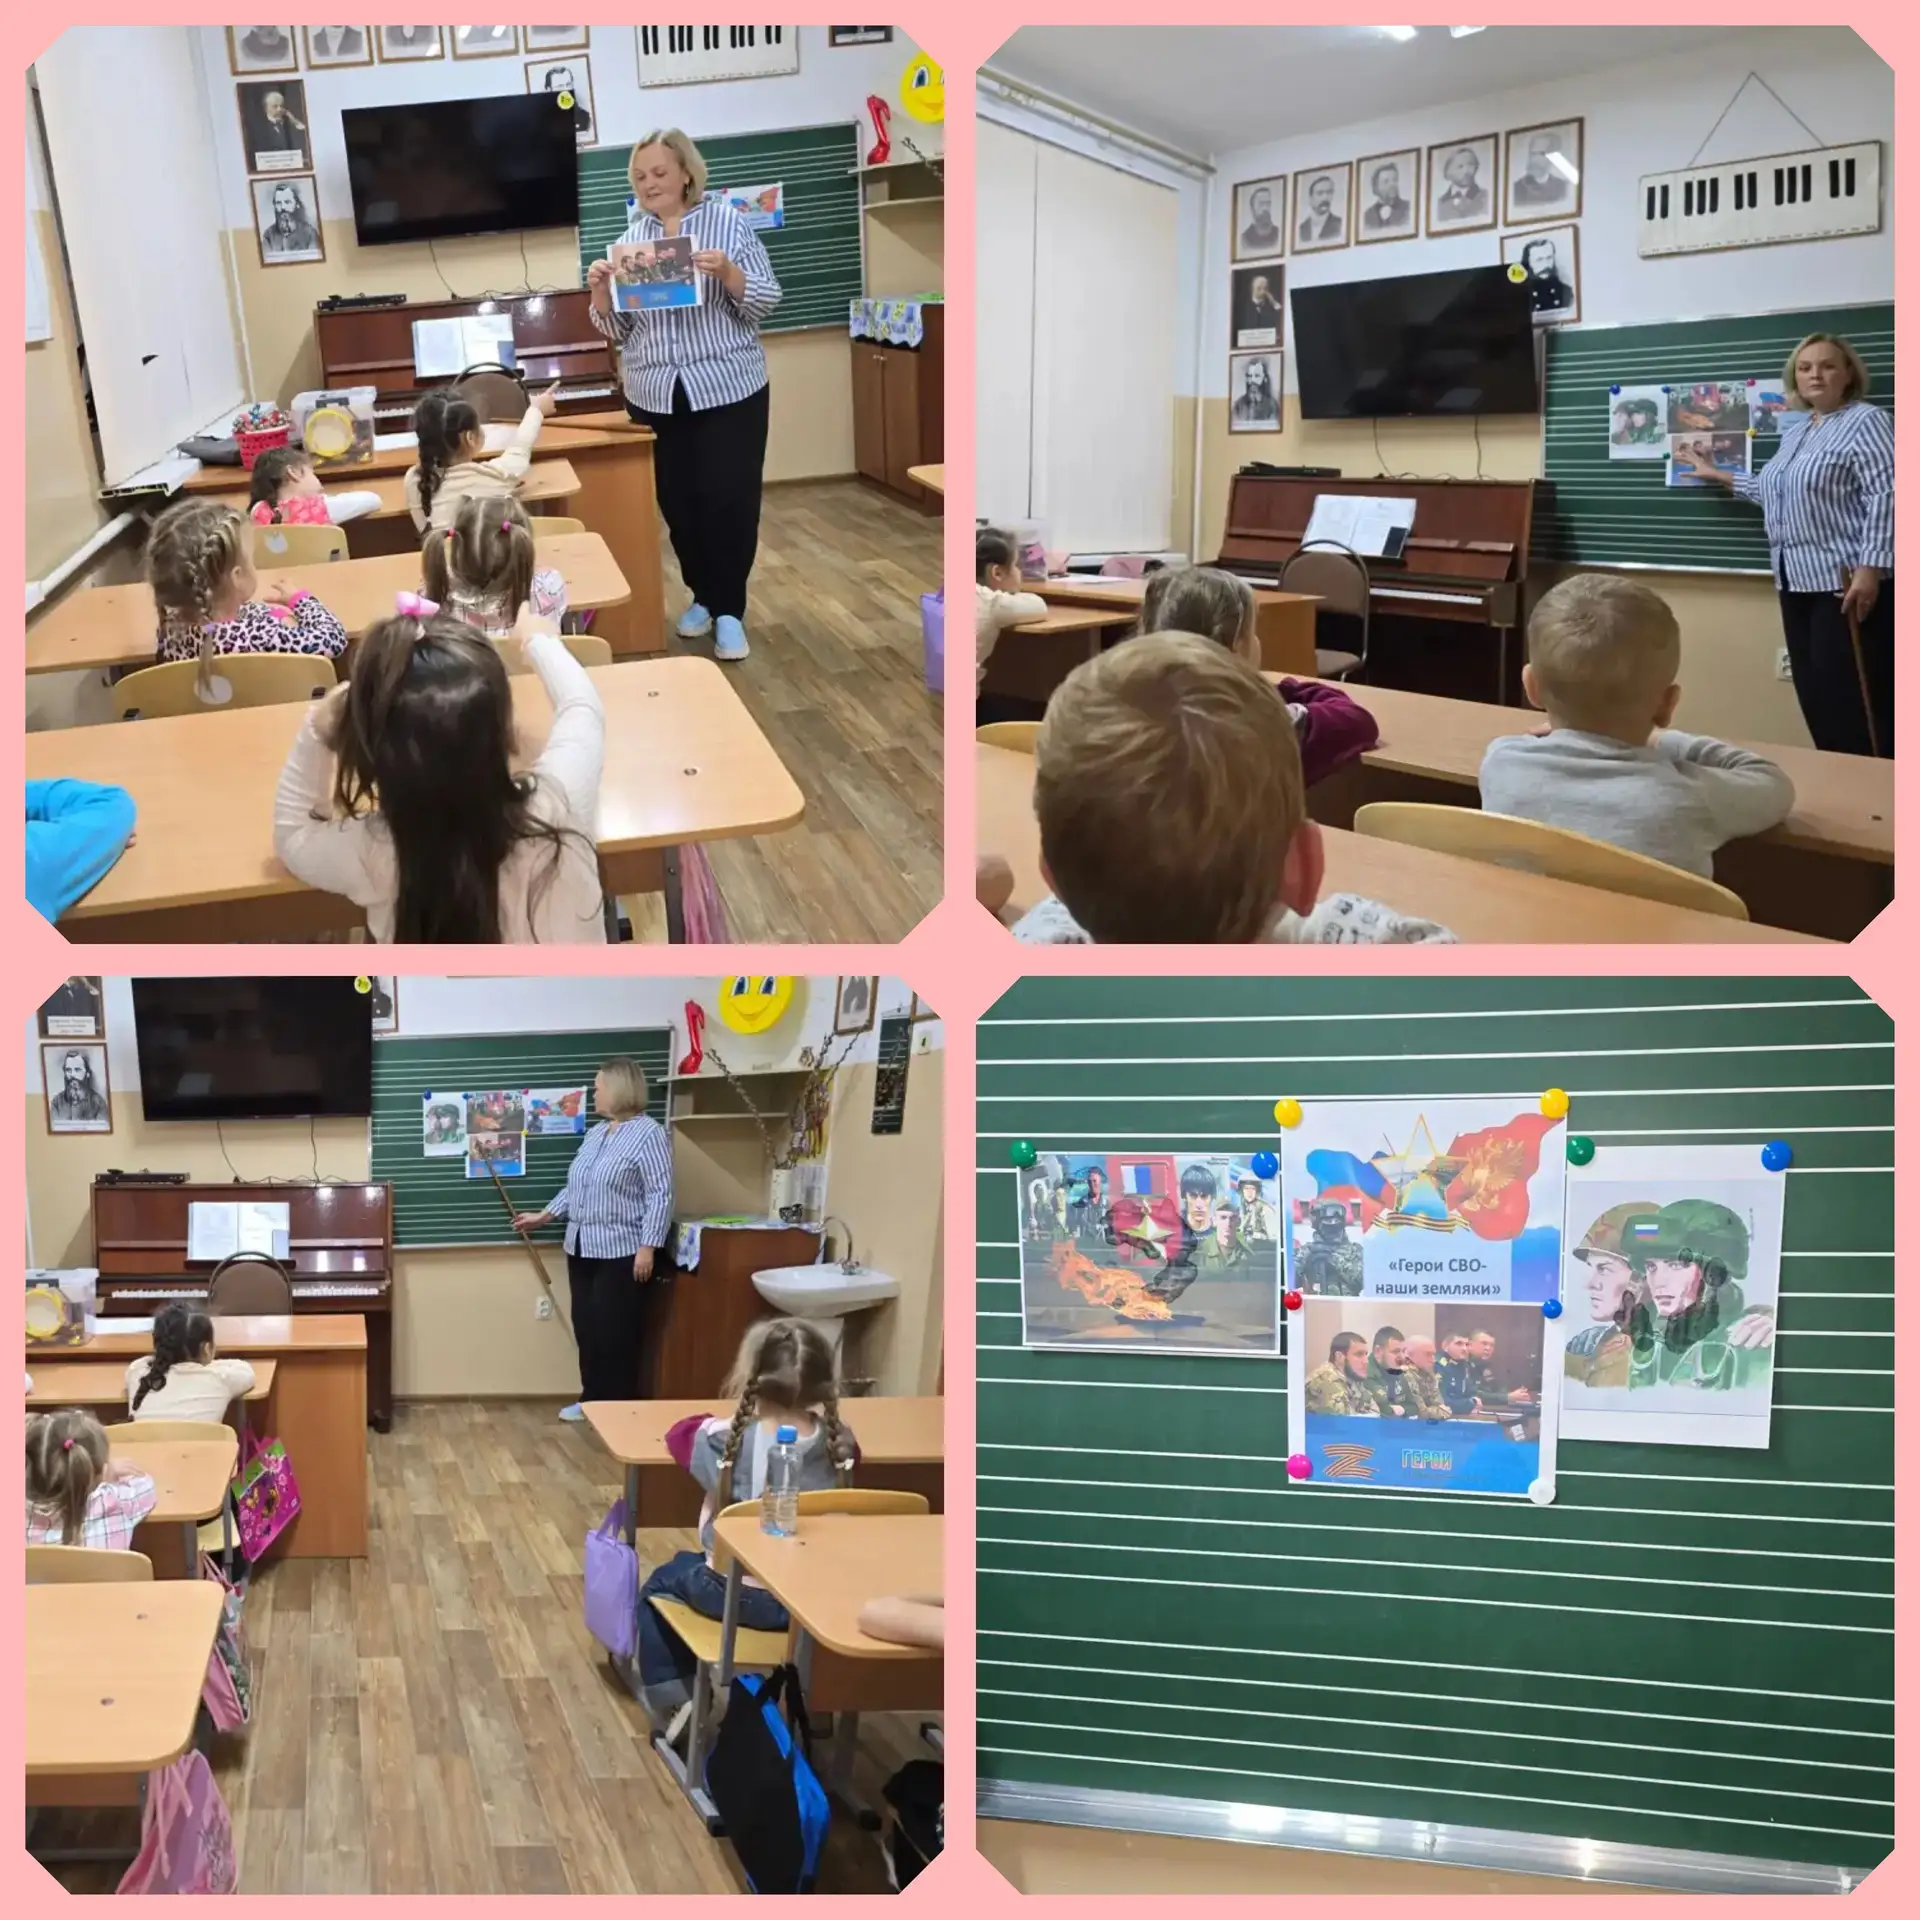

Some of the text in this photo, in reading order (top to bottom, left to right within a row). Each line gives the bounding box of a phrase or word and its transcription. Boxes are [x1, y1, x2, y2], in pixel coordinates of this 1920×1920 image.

[1388, 1258, 1488, 1275] «Герои СВО-
[1375, 1283, 1502, 1296] наши земляки»
[1401, 1449, 1452, 1470] ГЕРОИ
